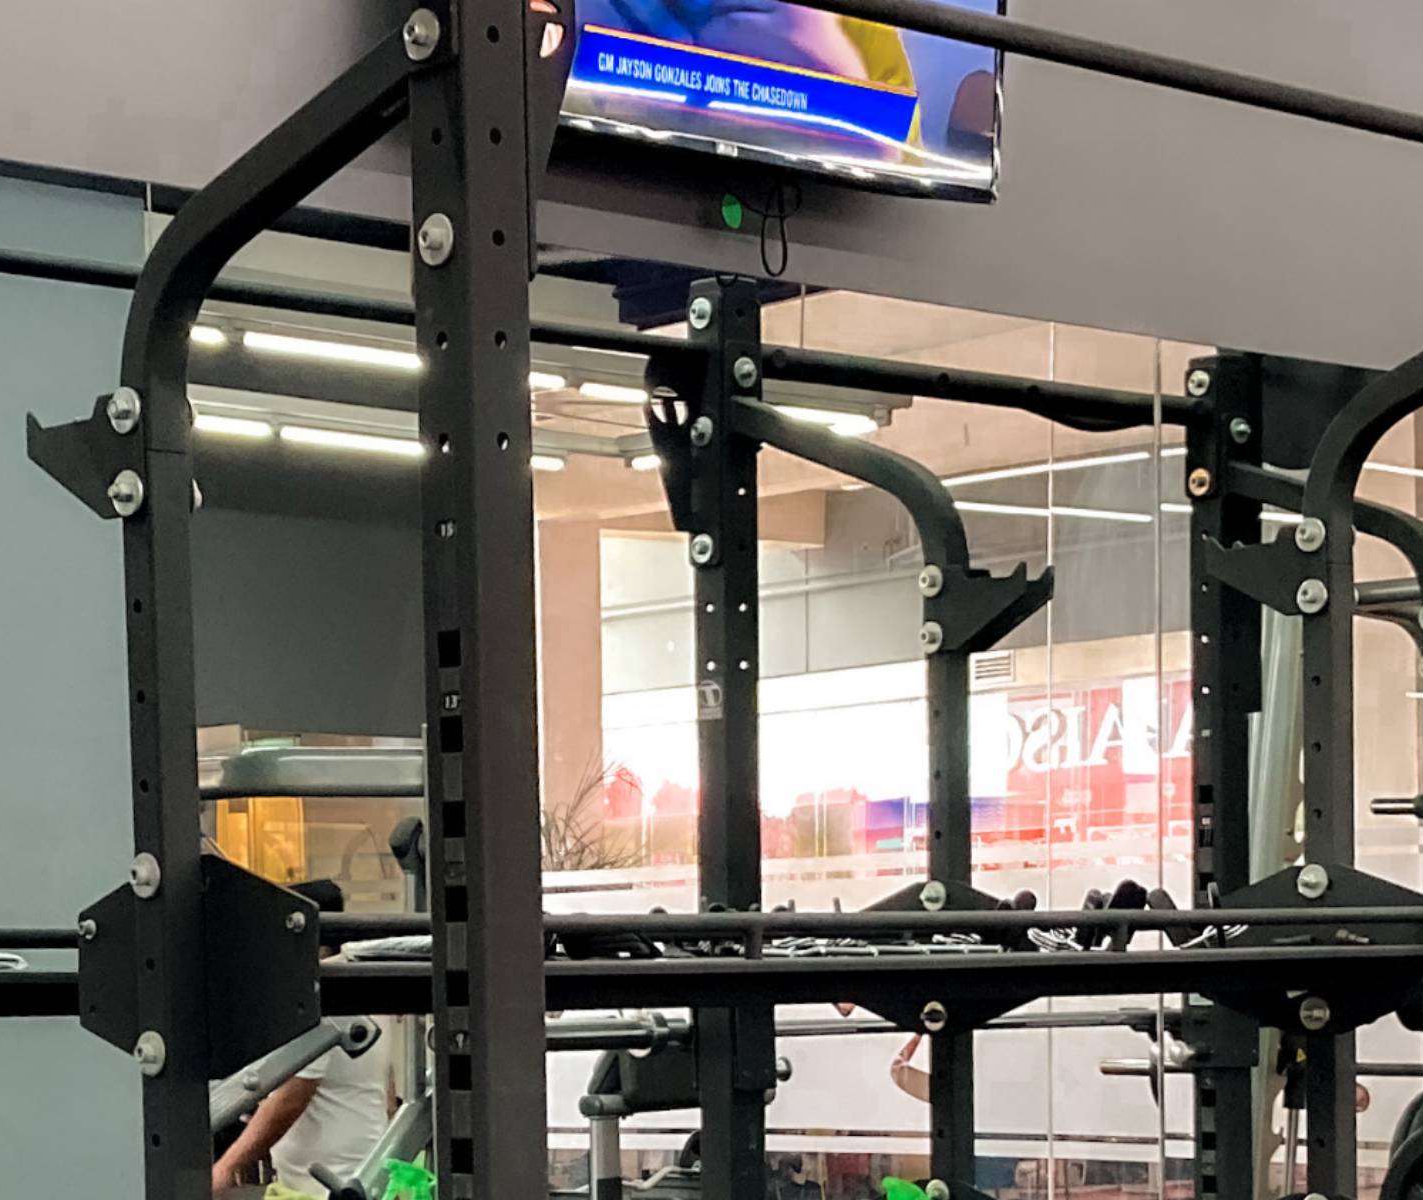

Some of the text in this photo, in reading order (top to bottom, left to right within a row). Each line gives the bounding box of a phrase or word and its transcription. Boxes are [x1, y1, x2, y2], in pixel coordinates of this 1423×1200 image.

[616, 56, 653, 80] JAYSON
[654, 64, 702, 91] GONZALES
[704, 74, 730, 96] JOINS
[733, 79, 750, 99] THE
[752, 83, 808, 112] CHASEDOWN
